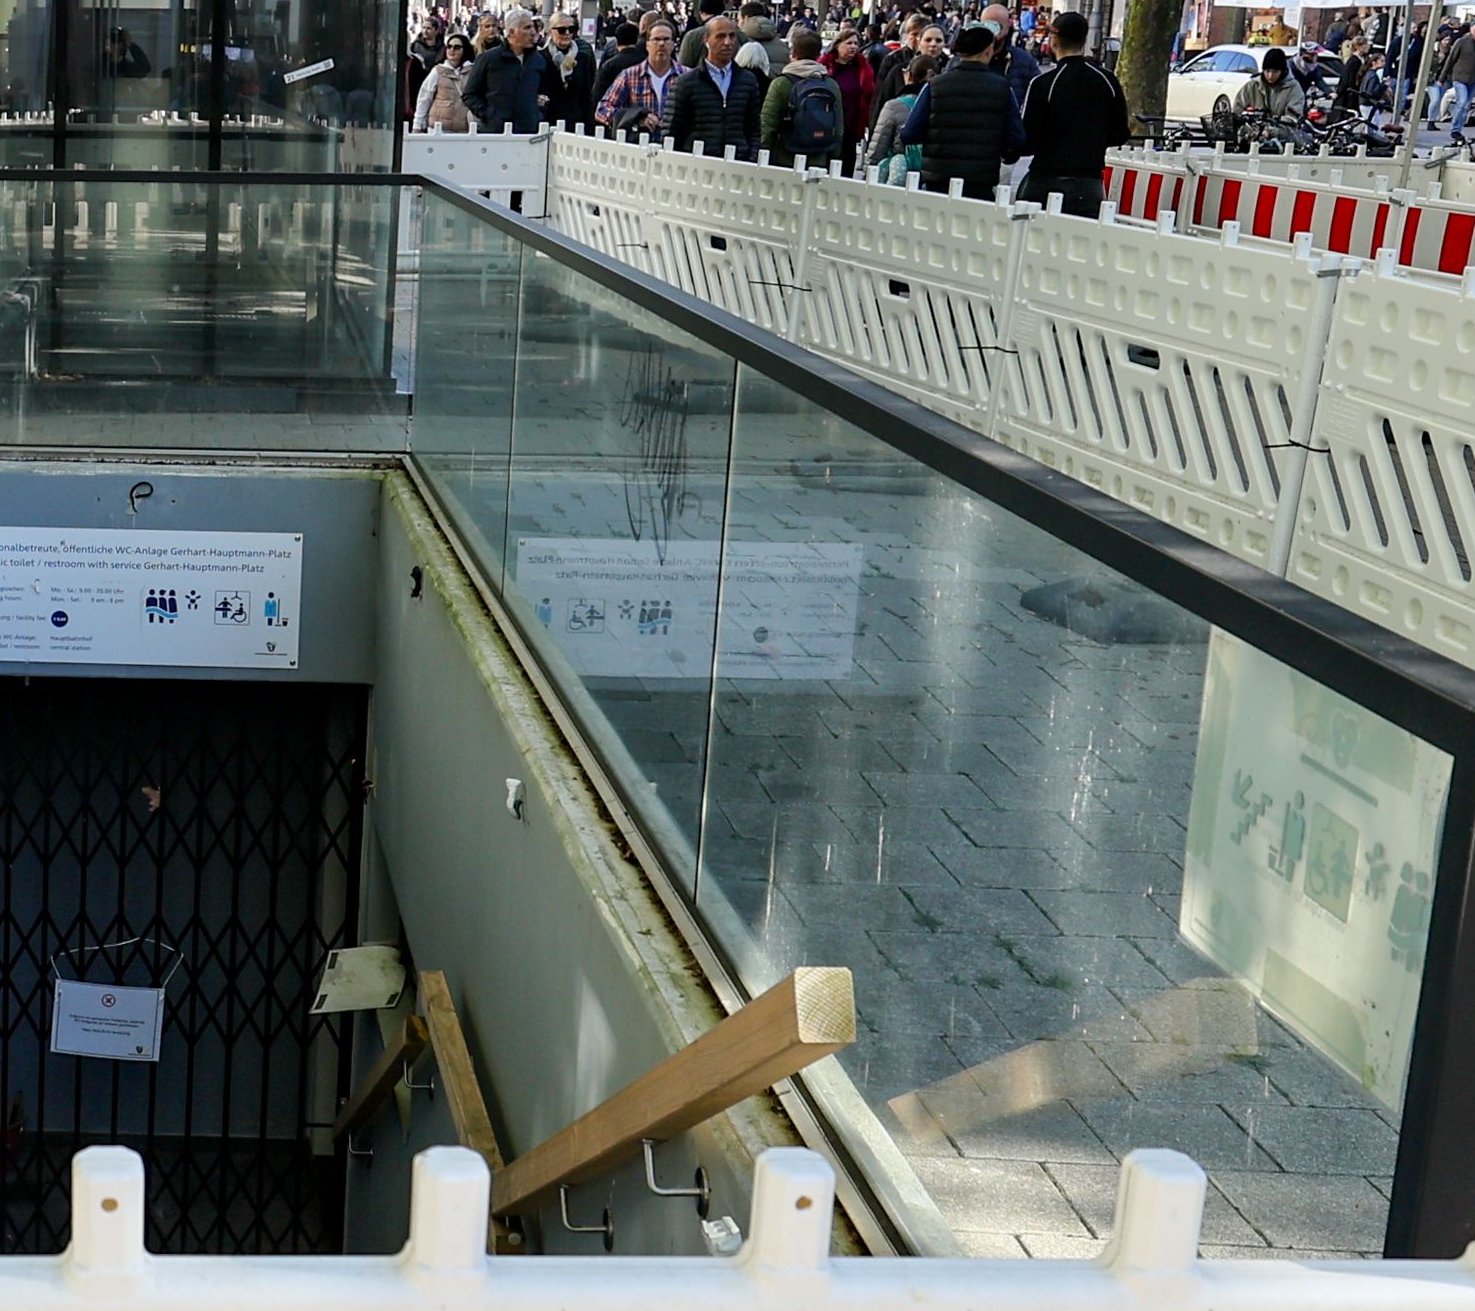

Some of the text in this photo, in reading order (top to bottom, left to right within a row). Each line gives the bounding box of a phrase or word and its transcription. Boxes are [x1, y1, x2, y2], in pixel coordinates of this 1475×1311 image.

[62, 543, 114, 555] öffentliche
[115, 546, 168, 557] WC-Anlage
[170, 547, 292, 559] Gerhart-Hauptmann-Platz
[9, 558, 35, 567] toilet
[43, 559, 86, 568] restroom
[87, 559, 108, 569] with
[110, 561, 142, 570] service
[143, 561, 265, 573] Gerhart-Hauptmann-Platz
